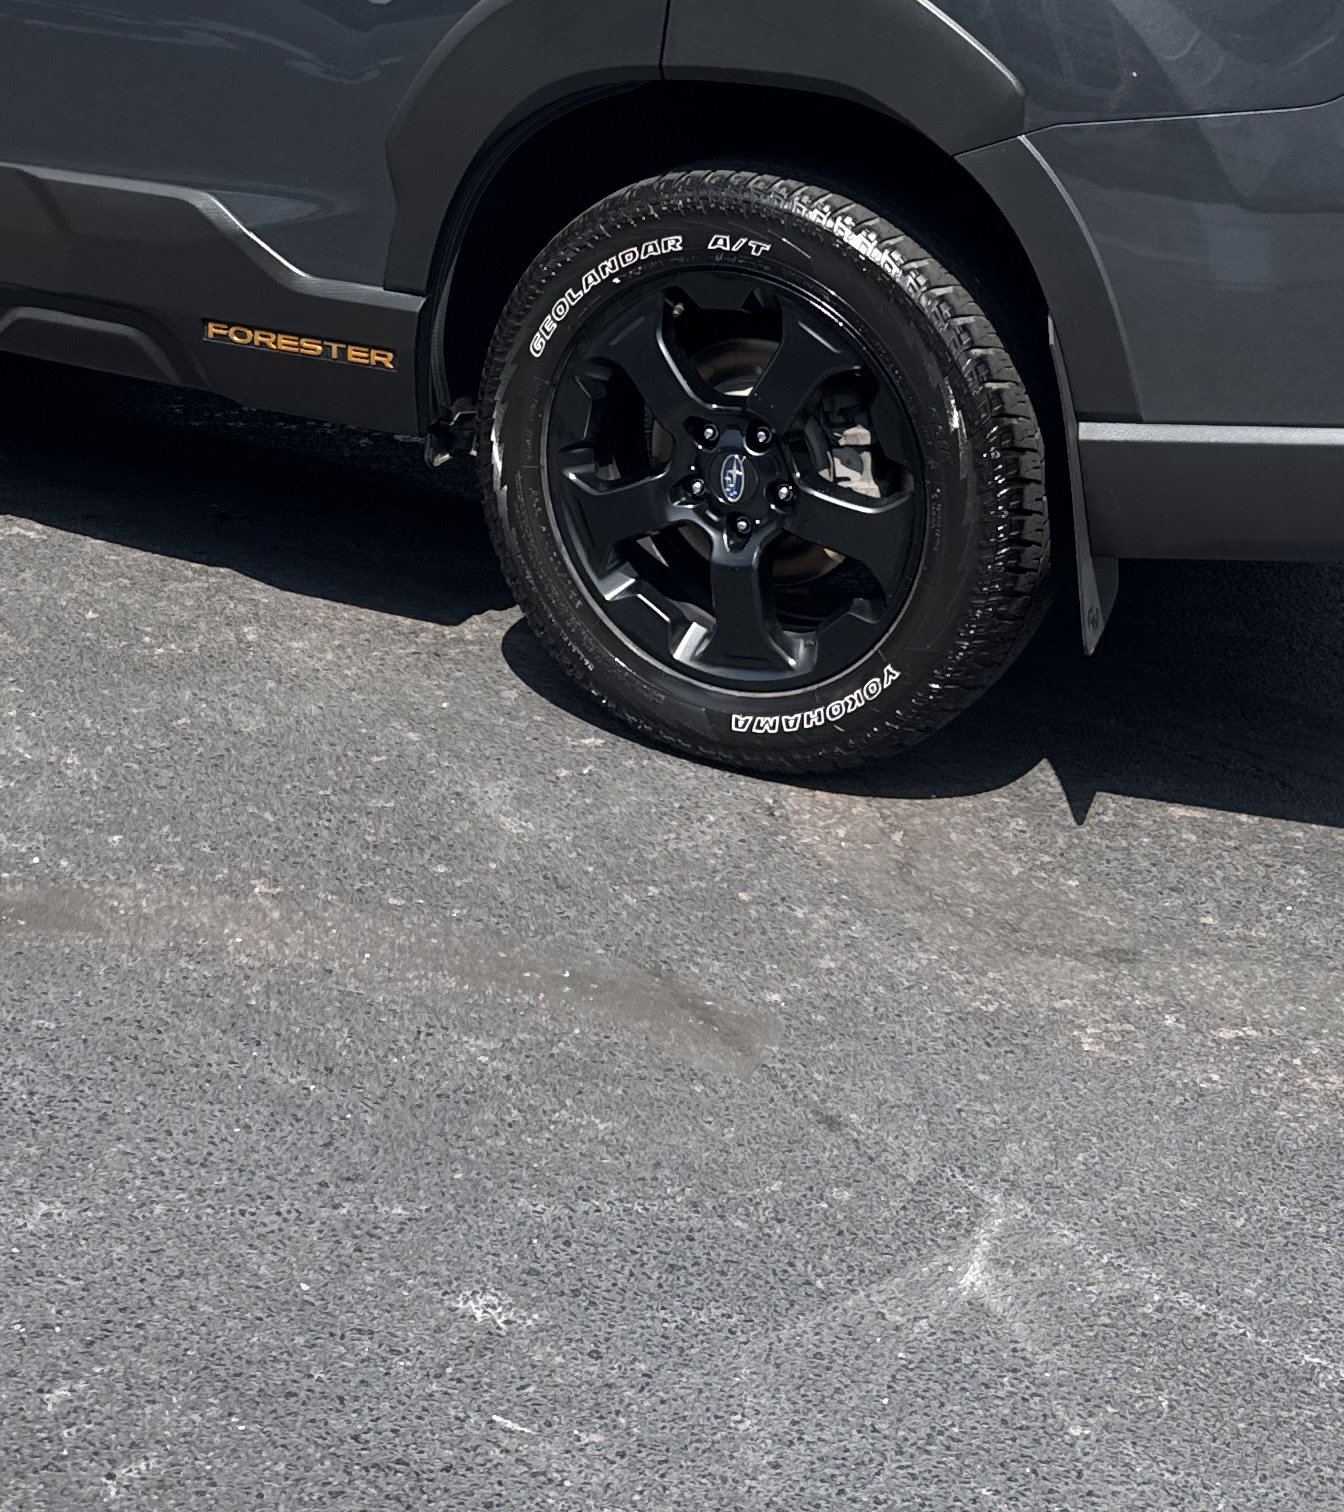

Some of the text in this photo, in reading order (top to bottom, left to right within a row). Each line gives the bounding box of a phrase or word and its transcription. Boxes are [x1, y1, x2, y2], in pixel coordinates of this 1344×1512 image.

[528, 233, 773, 359] GEOLANDAR A/T
[206, 321, 395, 370] FORESTER
[730, 663, 901, 735] YOKOHAMA
